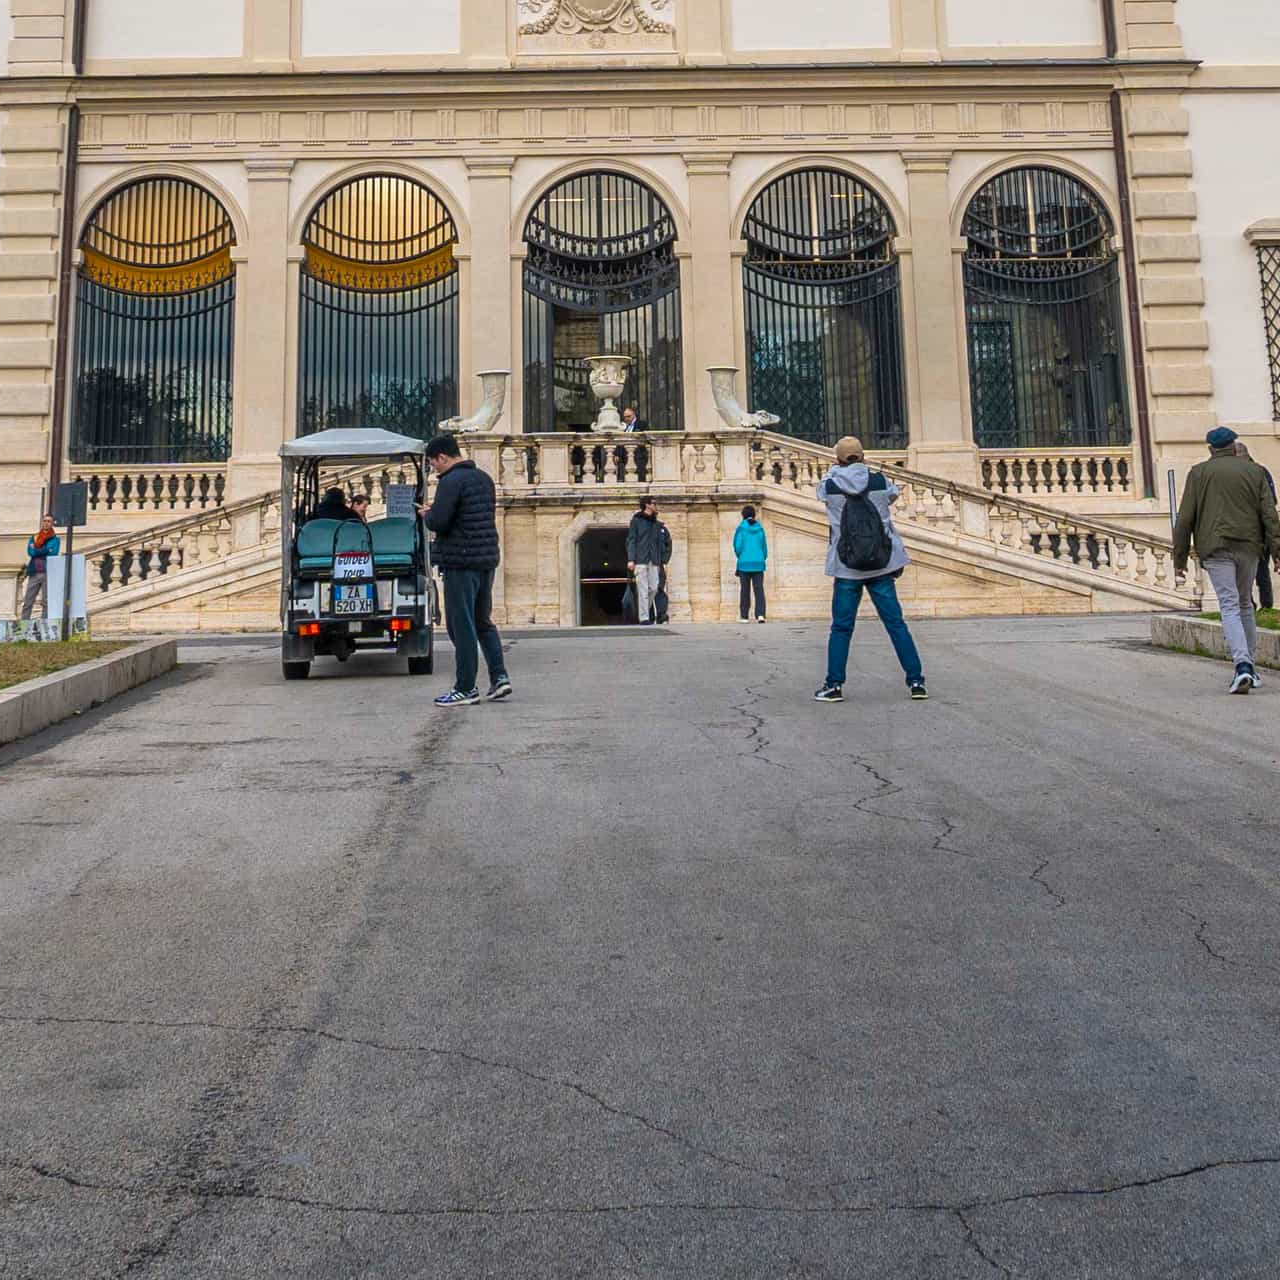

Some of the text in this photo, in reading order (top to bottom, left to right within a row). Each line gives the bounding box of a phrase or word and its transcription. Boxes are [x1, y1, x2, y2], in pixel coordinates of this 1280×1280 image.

[337, 556, 369, 565] GUIDED
[347, 586, 360, 599] ZA
[336, 600, 372, 612] 520 XH
